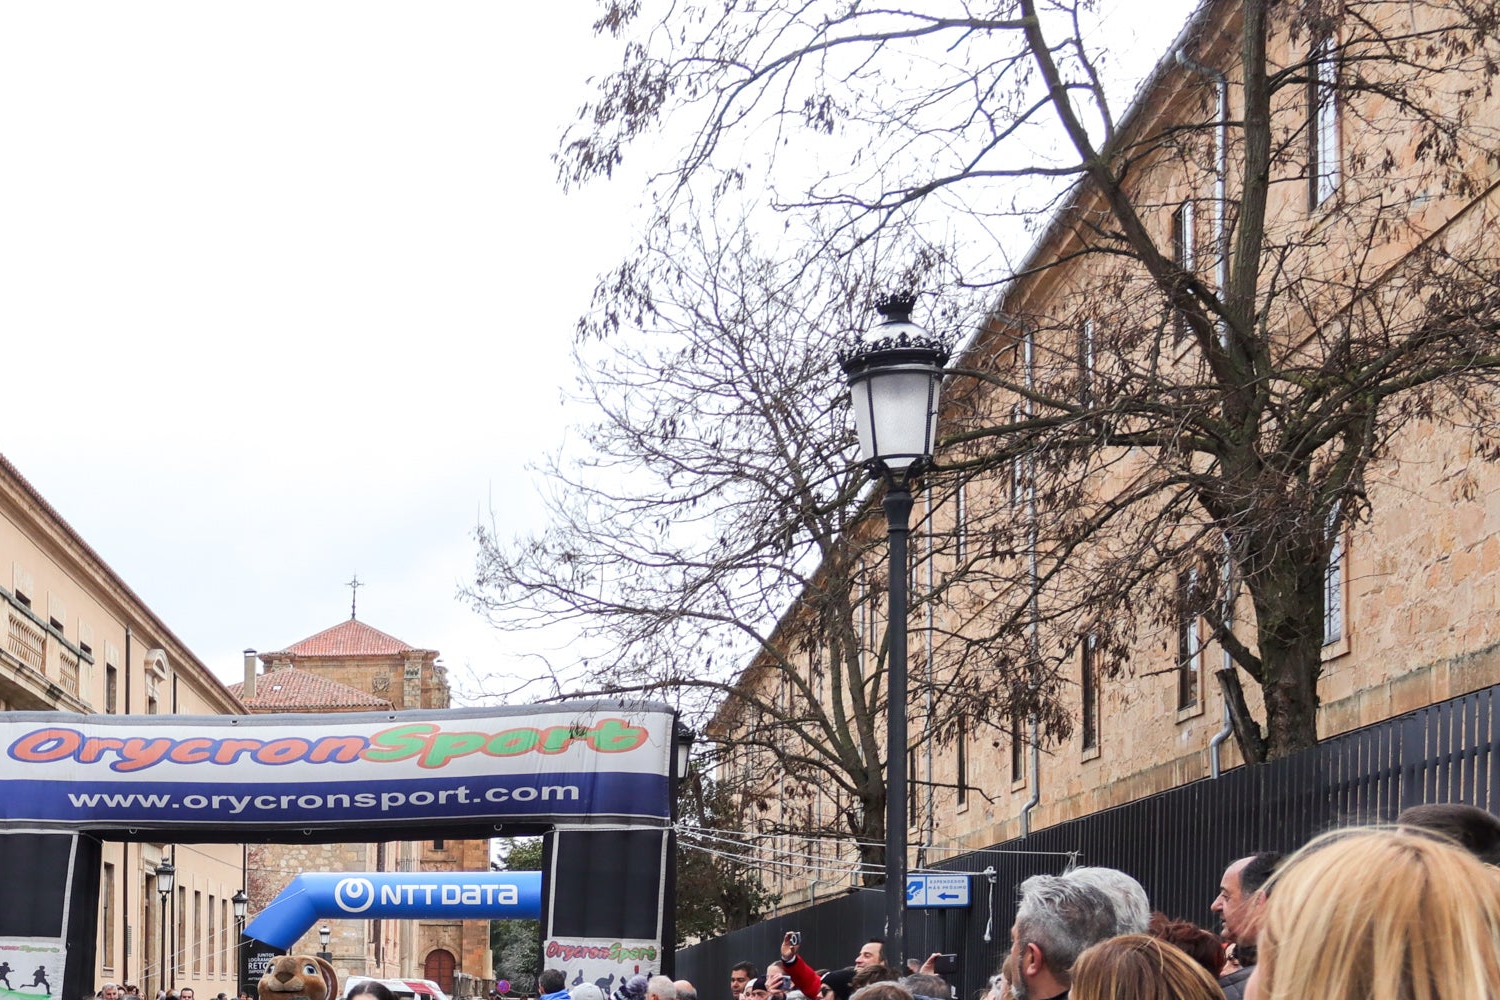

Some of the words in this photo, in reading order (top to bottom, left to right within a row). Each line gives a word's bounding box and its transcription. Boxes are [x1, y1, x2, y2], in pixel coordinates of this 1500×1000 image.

[7, 718, 649, 772] OrycronSport
[68, 785, 579, 813] www.orycronsport.com
[381, 885, 437, 905] NTT
